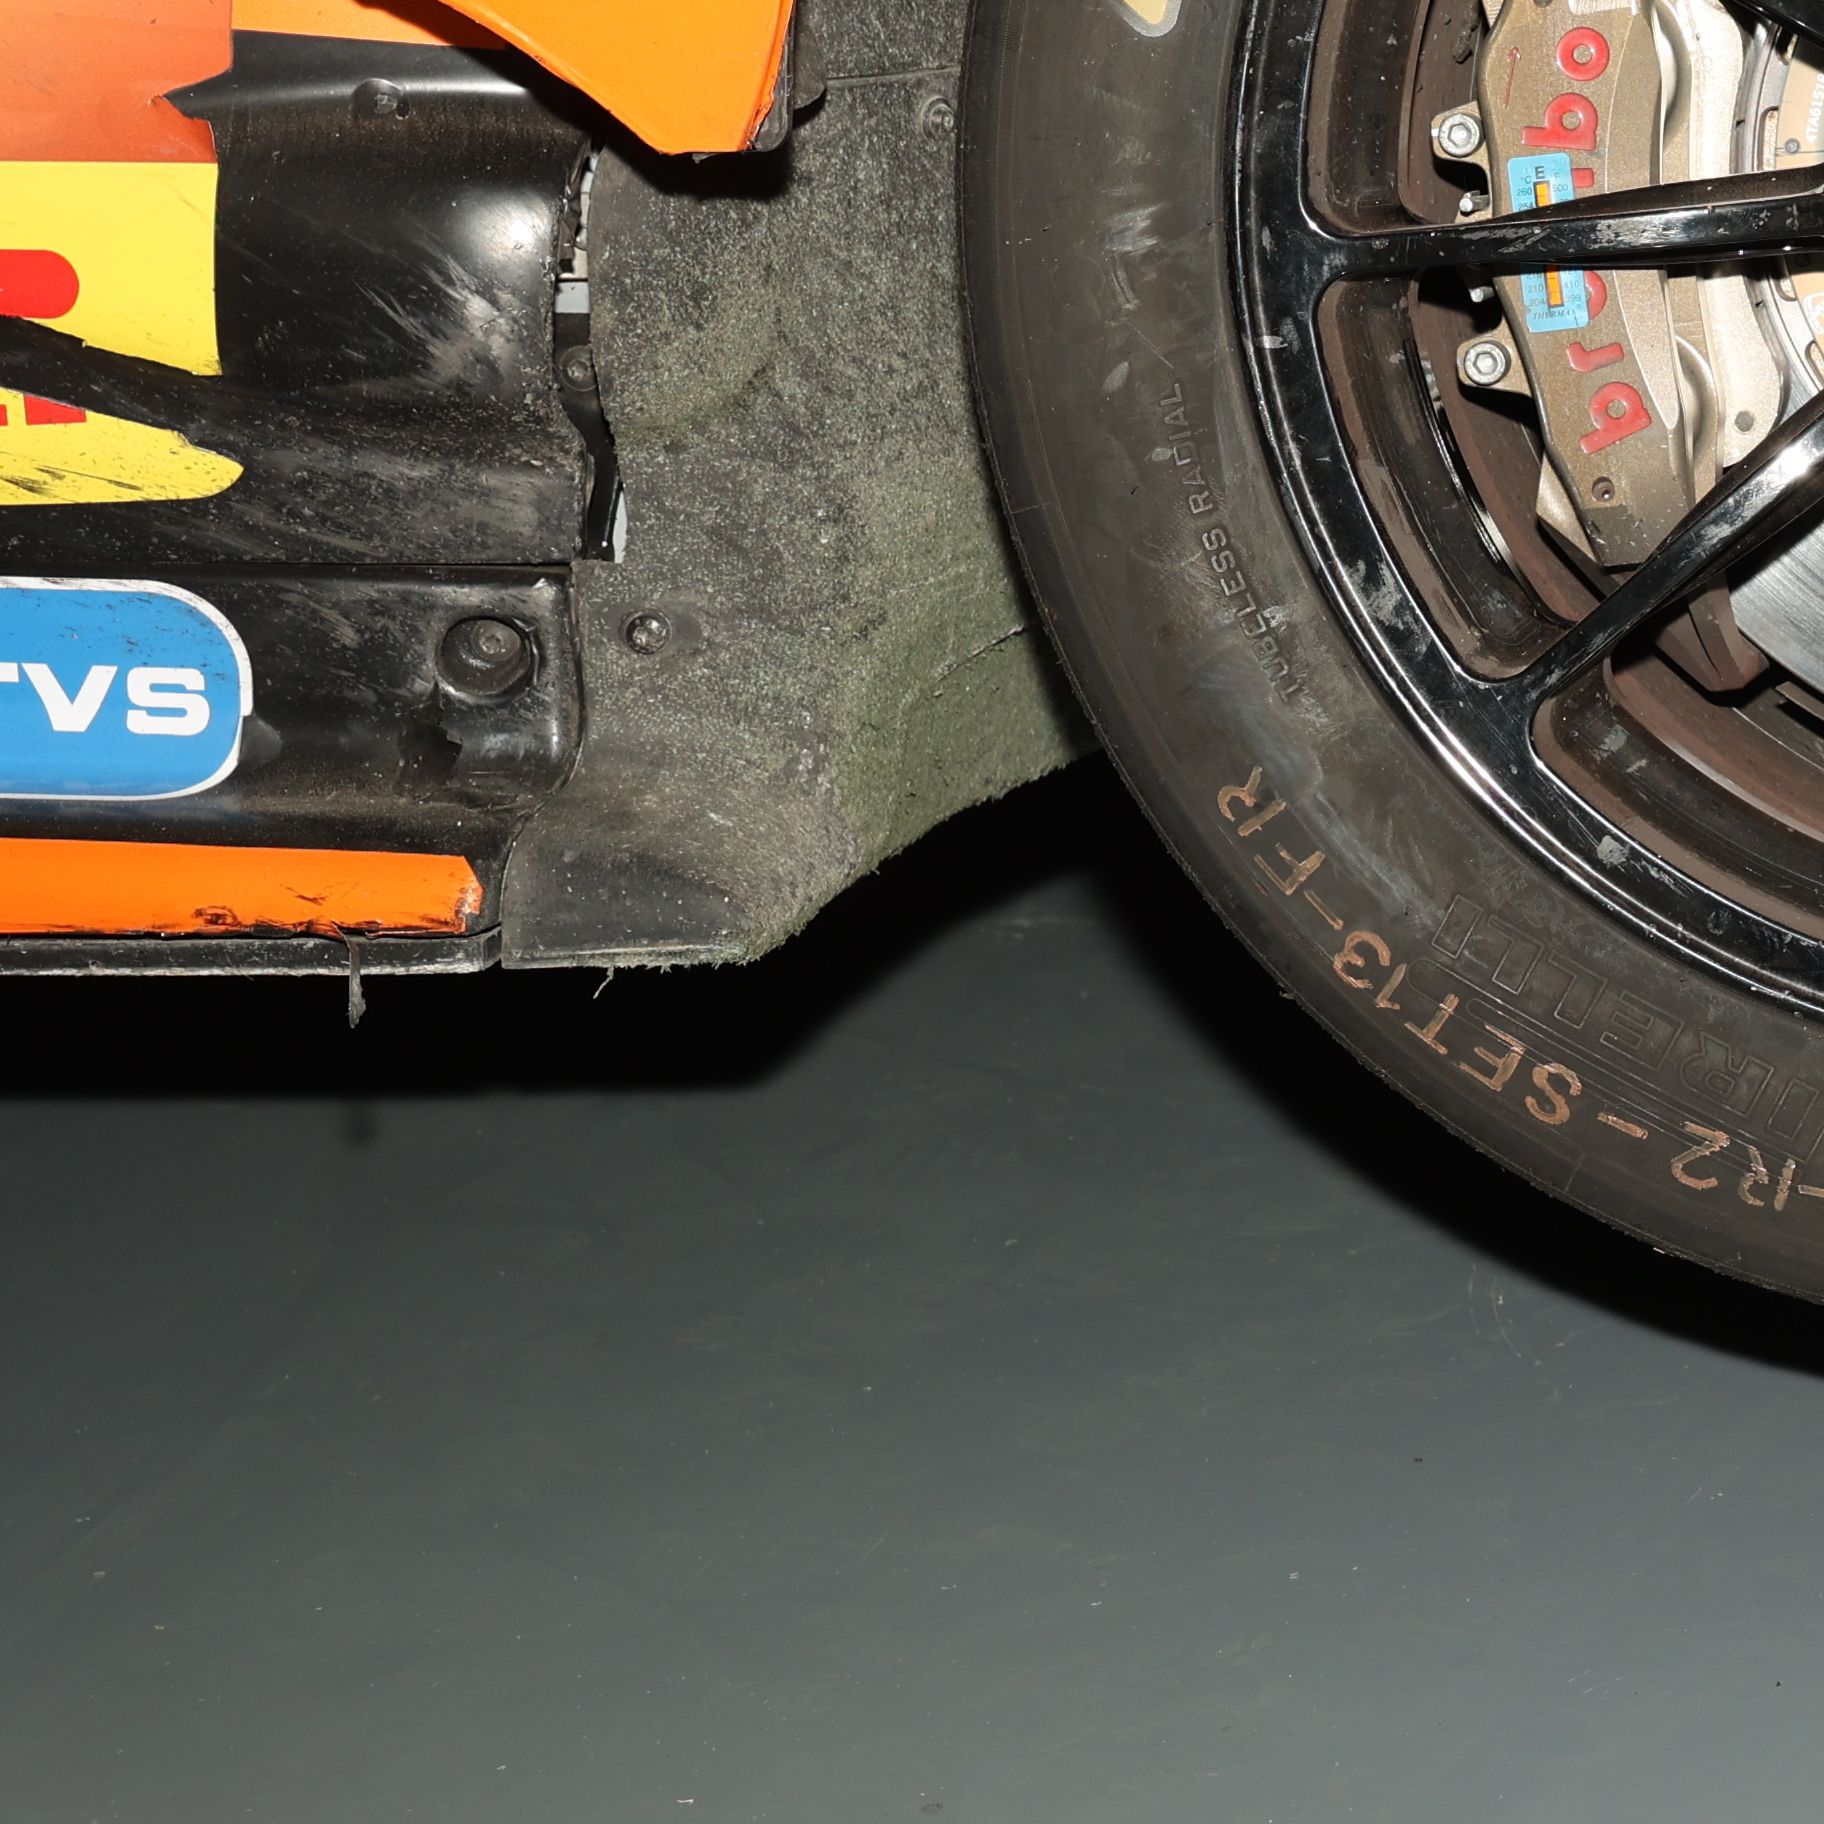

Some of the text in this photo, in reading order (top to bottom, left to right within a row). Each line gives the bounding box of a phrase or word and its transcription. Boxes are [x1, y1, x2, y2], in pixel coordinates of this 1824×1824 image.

[1521, 26, 1652, 454] brbo
[1160, 383, 1299, 705] TUBELESS RADIAL
